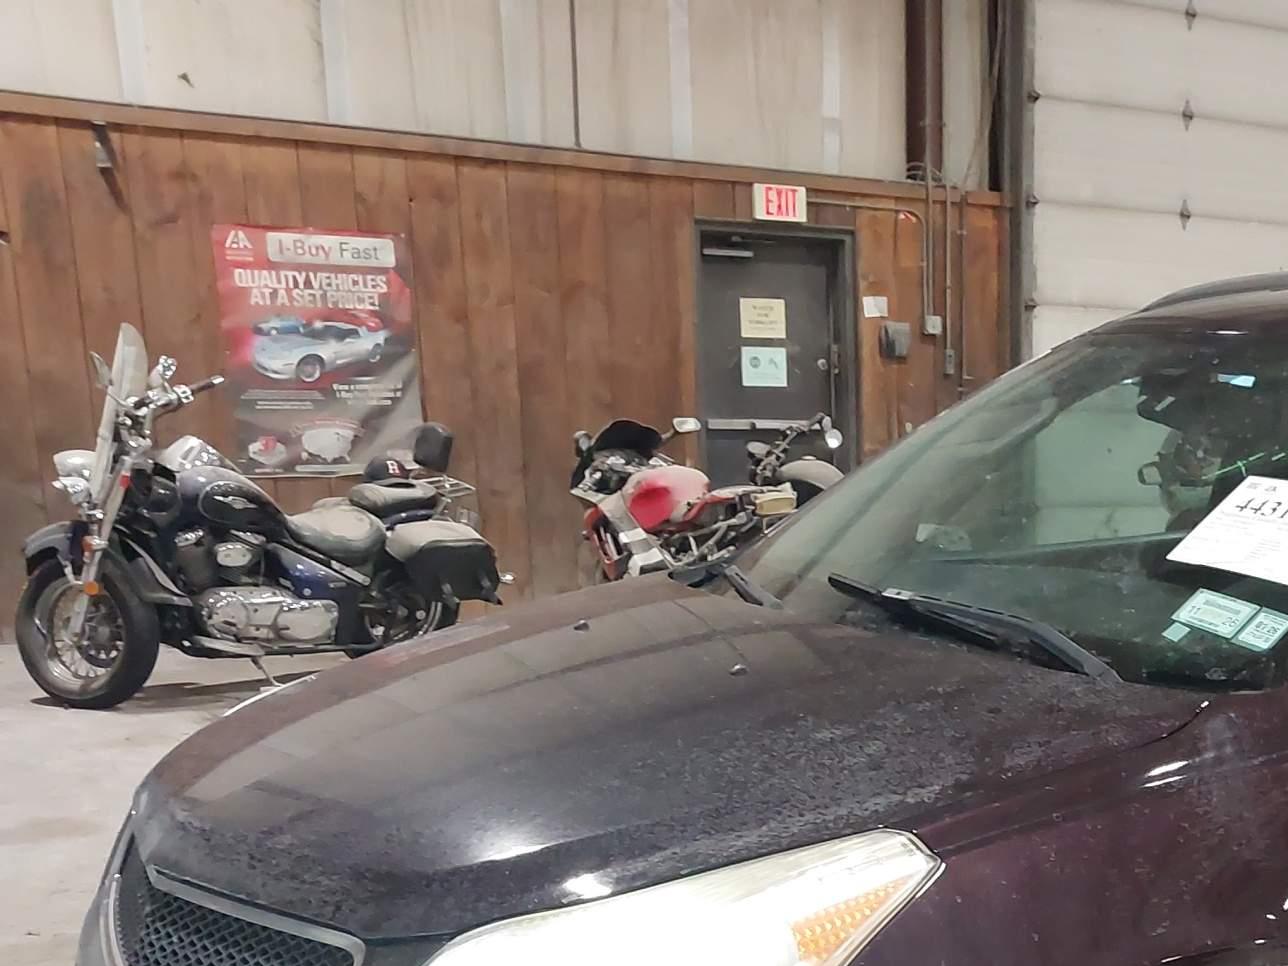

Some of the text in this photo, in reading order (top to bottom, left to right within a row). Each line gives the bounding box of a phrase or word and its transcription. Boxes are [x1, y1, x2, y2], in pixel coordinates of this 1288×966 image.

[765, 186, 798, 217] EXIT
[278, 240, 380, 261] I-Buy Fast
[233, 268, 388, 293] QUALITY VEHICLES
[250, 289, 380, 310] AT A SET PRICE!
